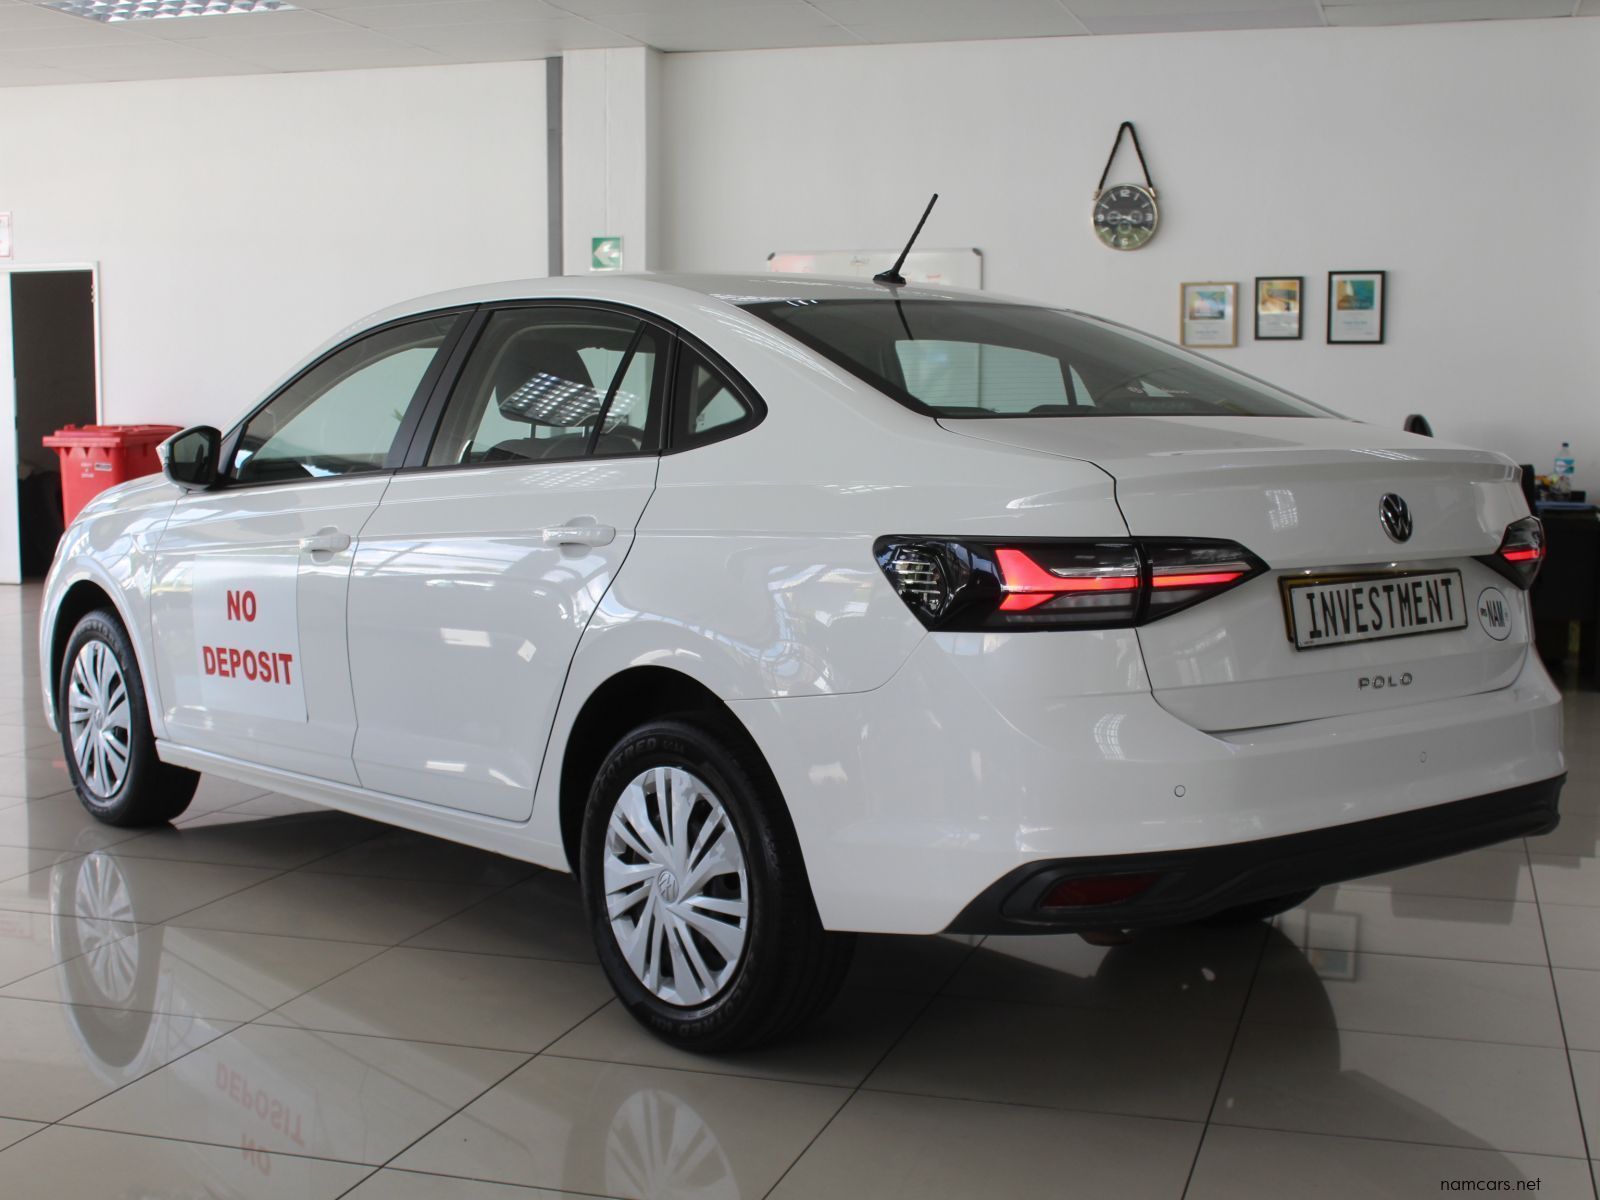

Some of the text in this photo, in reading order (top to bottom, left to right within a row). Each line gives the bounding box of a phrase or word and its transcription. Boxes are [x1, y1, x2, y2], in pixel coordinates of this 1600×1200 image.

[226, 589, 257, 622] NO
[1306, 578, 1453, 639] INVESTMENT
[1486, 600, 1506, 628] NAM
[202, 645, 293, 685] DEPOSIT
[1358, 672, 1413, 691] POLO
